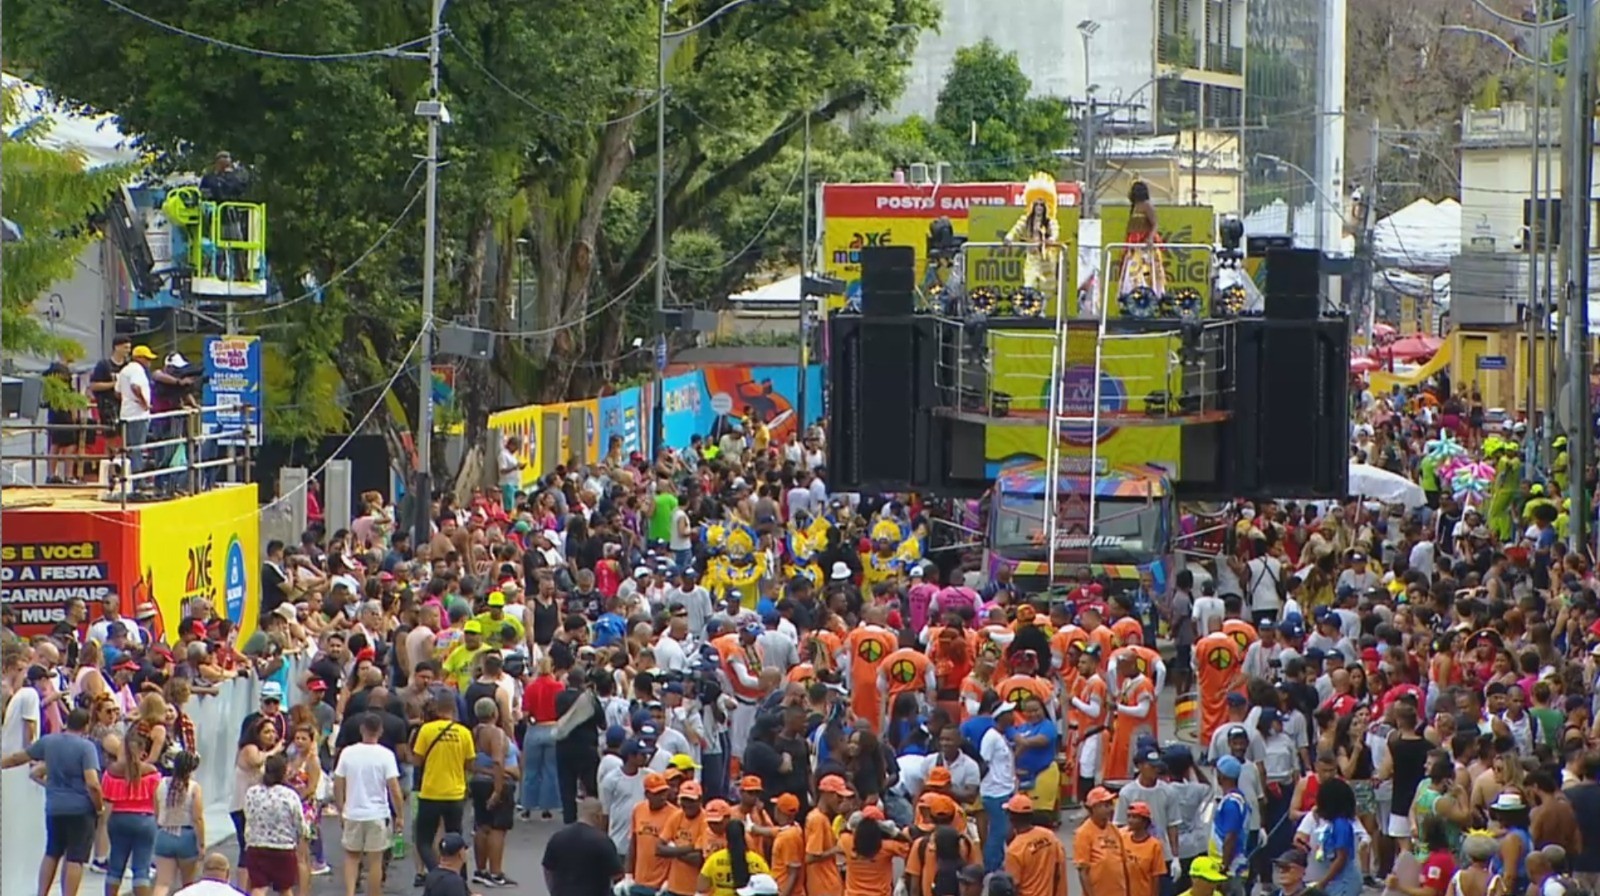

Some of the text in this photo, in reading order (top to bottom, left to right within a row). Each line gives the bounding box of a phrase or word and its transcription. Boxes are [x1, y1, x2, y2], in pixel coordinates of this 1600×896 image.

[876, 196, 934, 209] POSTO
[22, 546, 35, 559] E
[41, 543, 94, 559] VOCÊ
[20, 566, 35, 580] A
[41, 565, 102, 580] FESTA
[2, 587, 109, 602] CARNAVAIS
